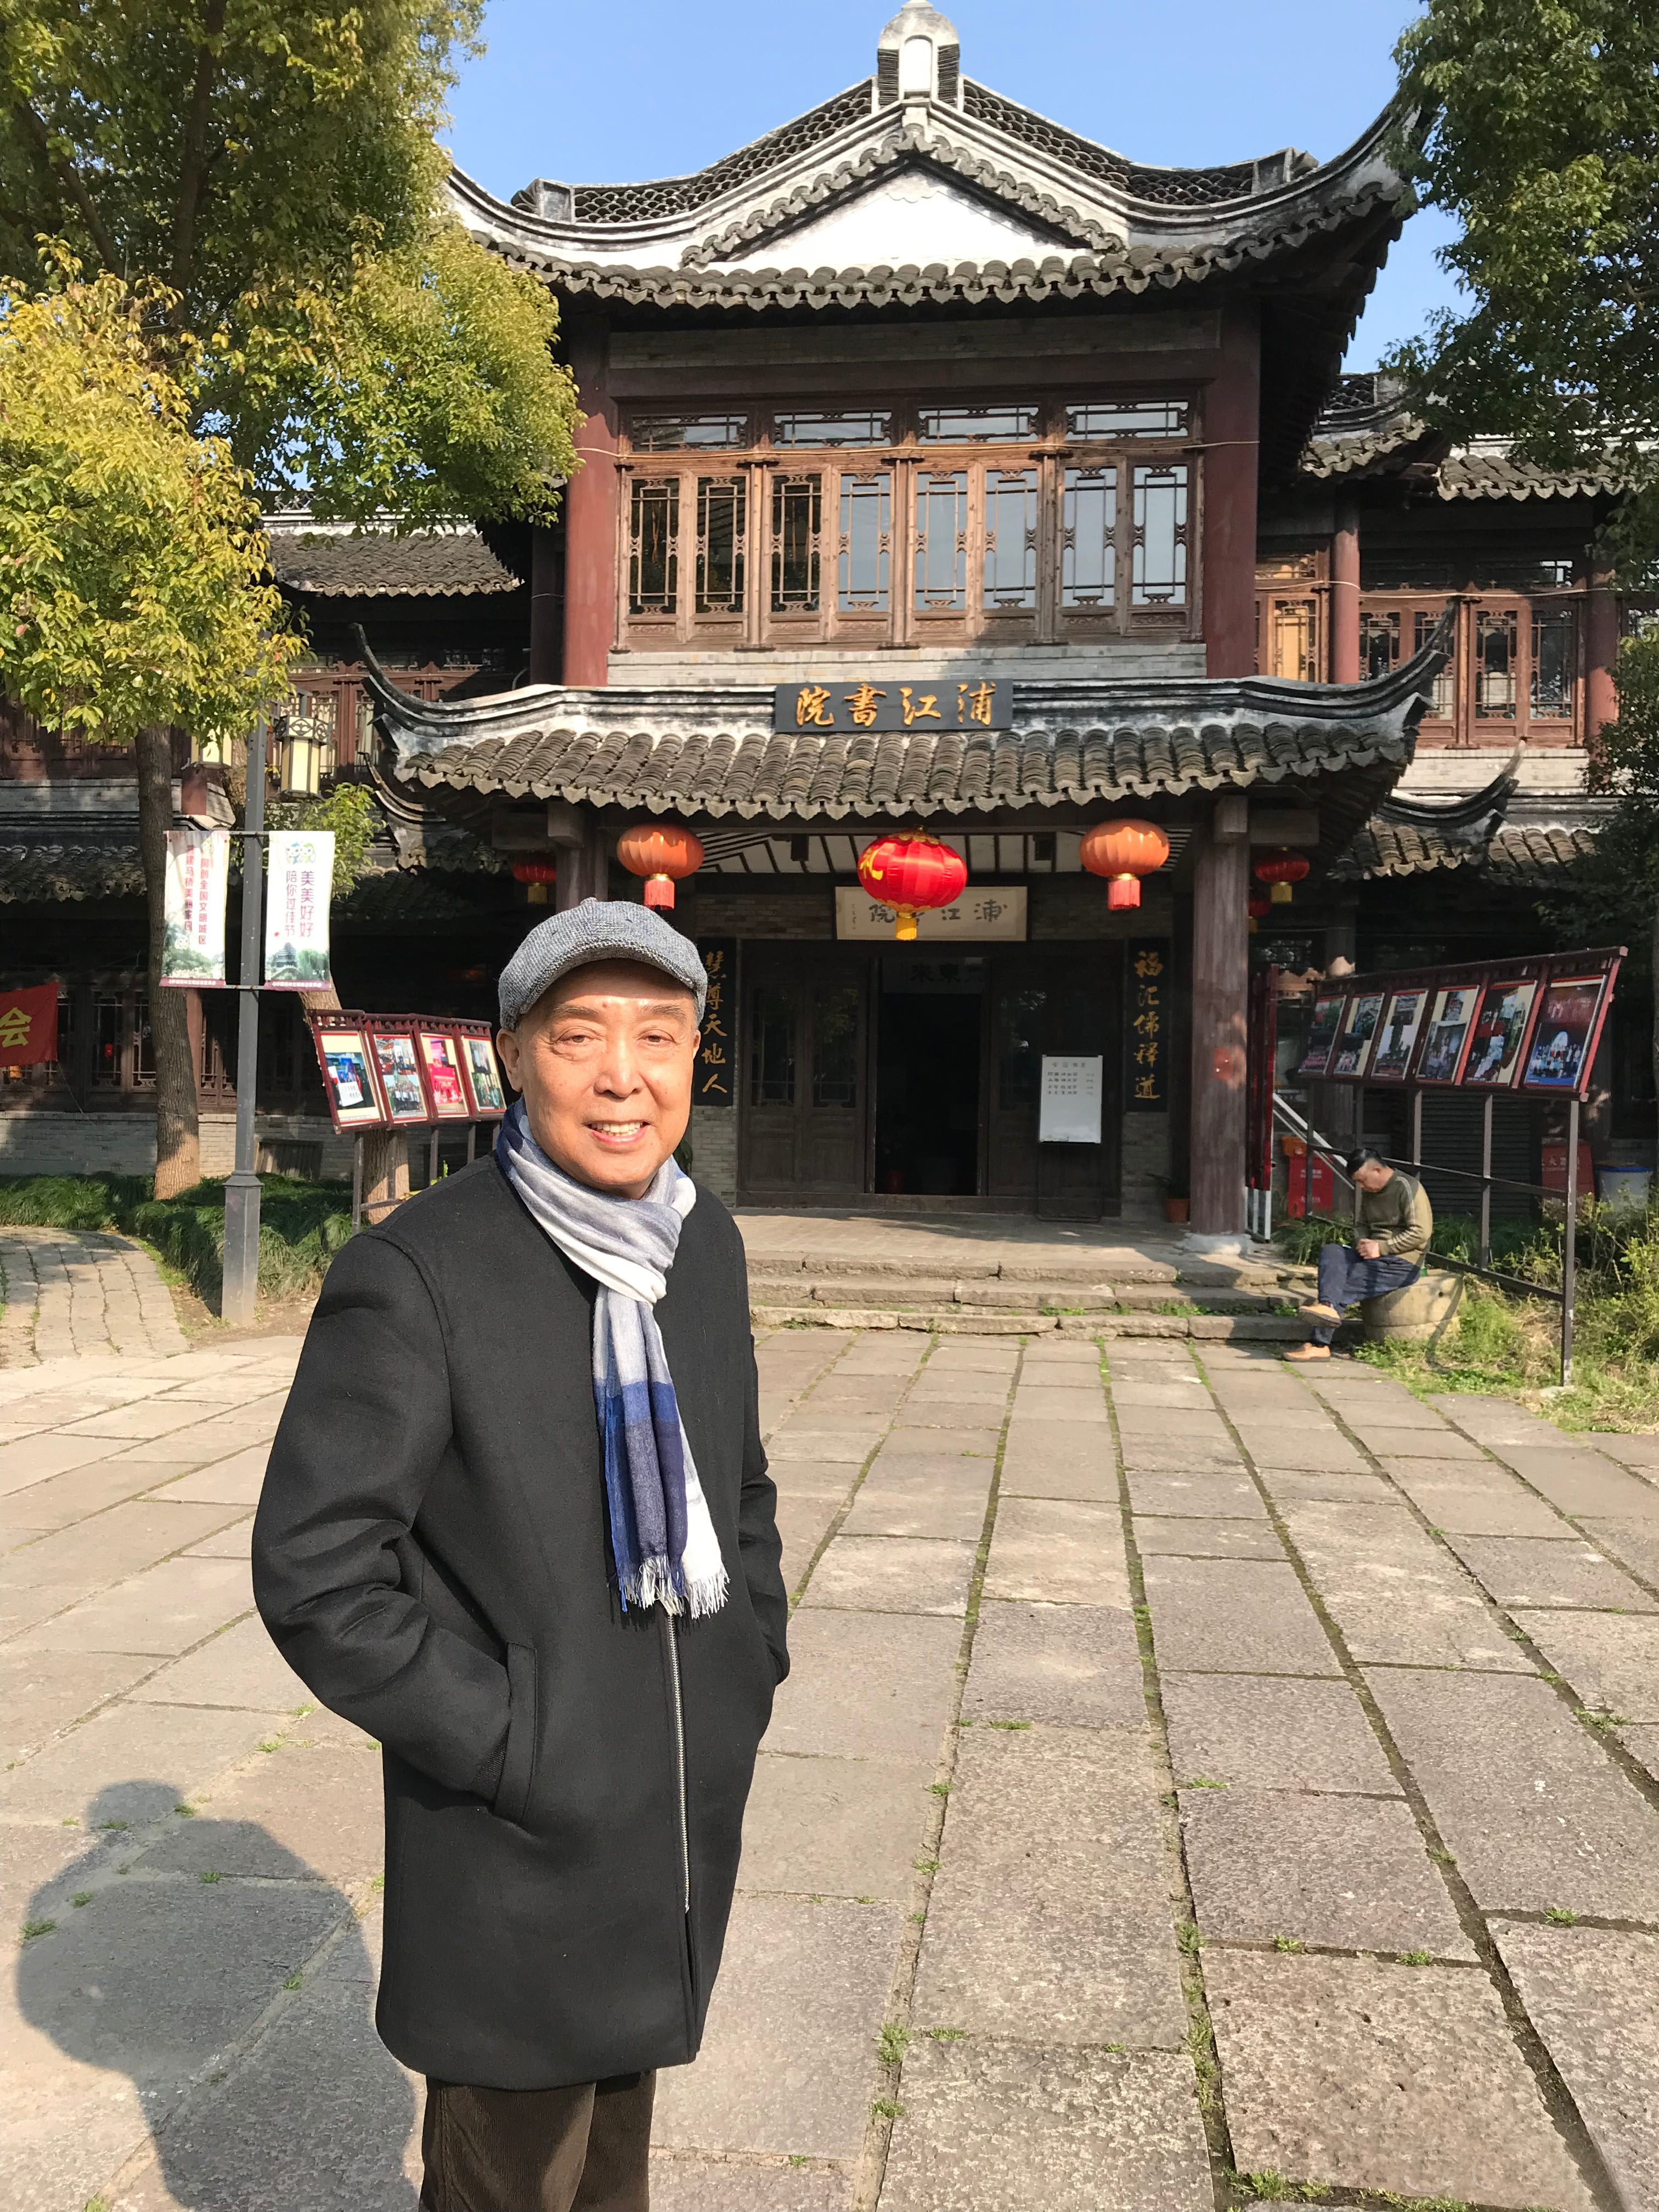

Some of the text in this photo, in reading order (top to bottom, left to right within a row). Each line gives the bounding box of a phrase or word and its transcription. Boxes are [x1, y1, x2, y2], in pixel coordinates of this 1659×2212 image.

[795, 681, 996, 727] 浦江書院
[199, 858, 210, 945] 同创全国文明城区
[285, 870, 297, 937] 陪你过佳节
[300, 871, 315, 938] 美美好好
[869, 898, 1008, 927] 浦江院
[0, 1007, 32, 1048] 会
